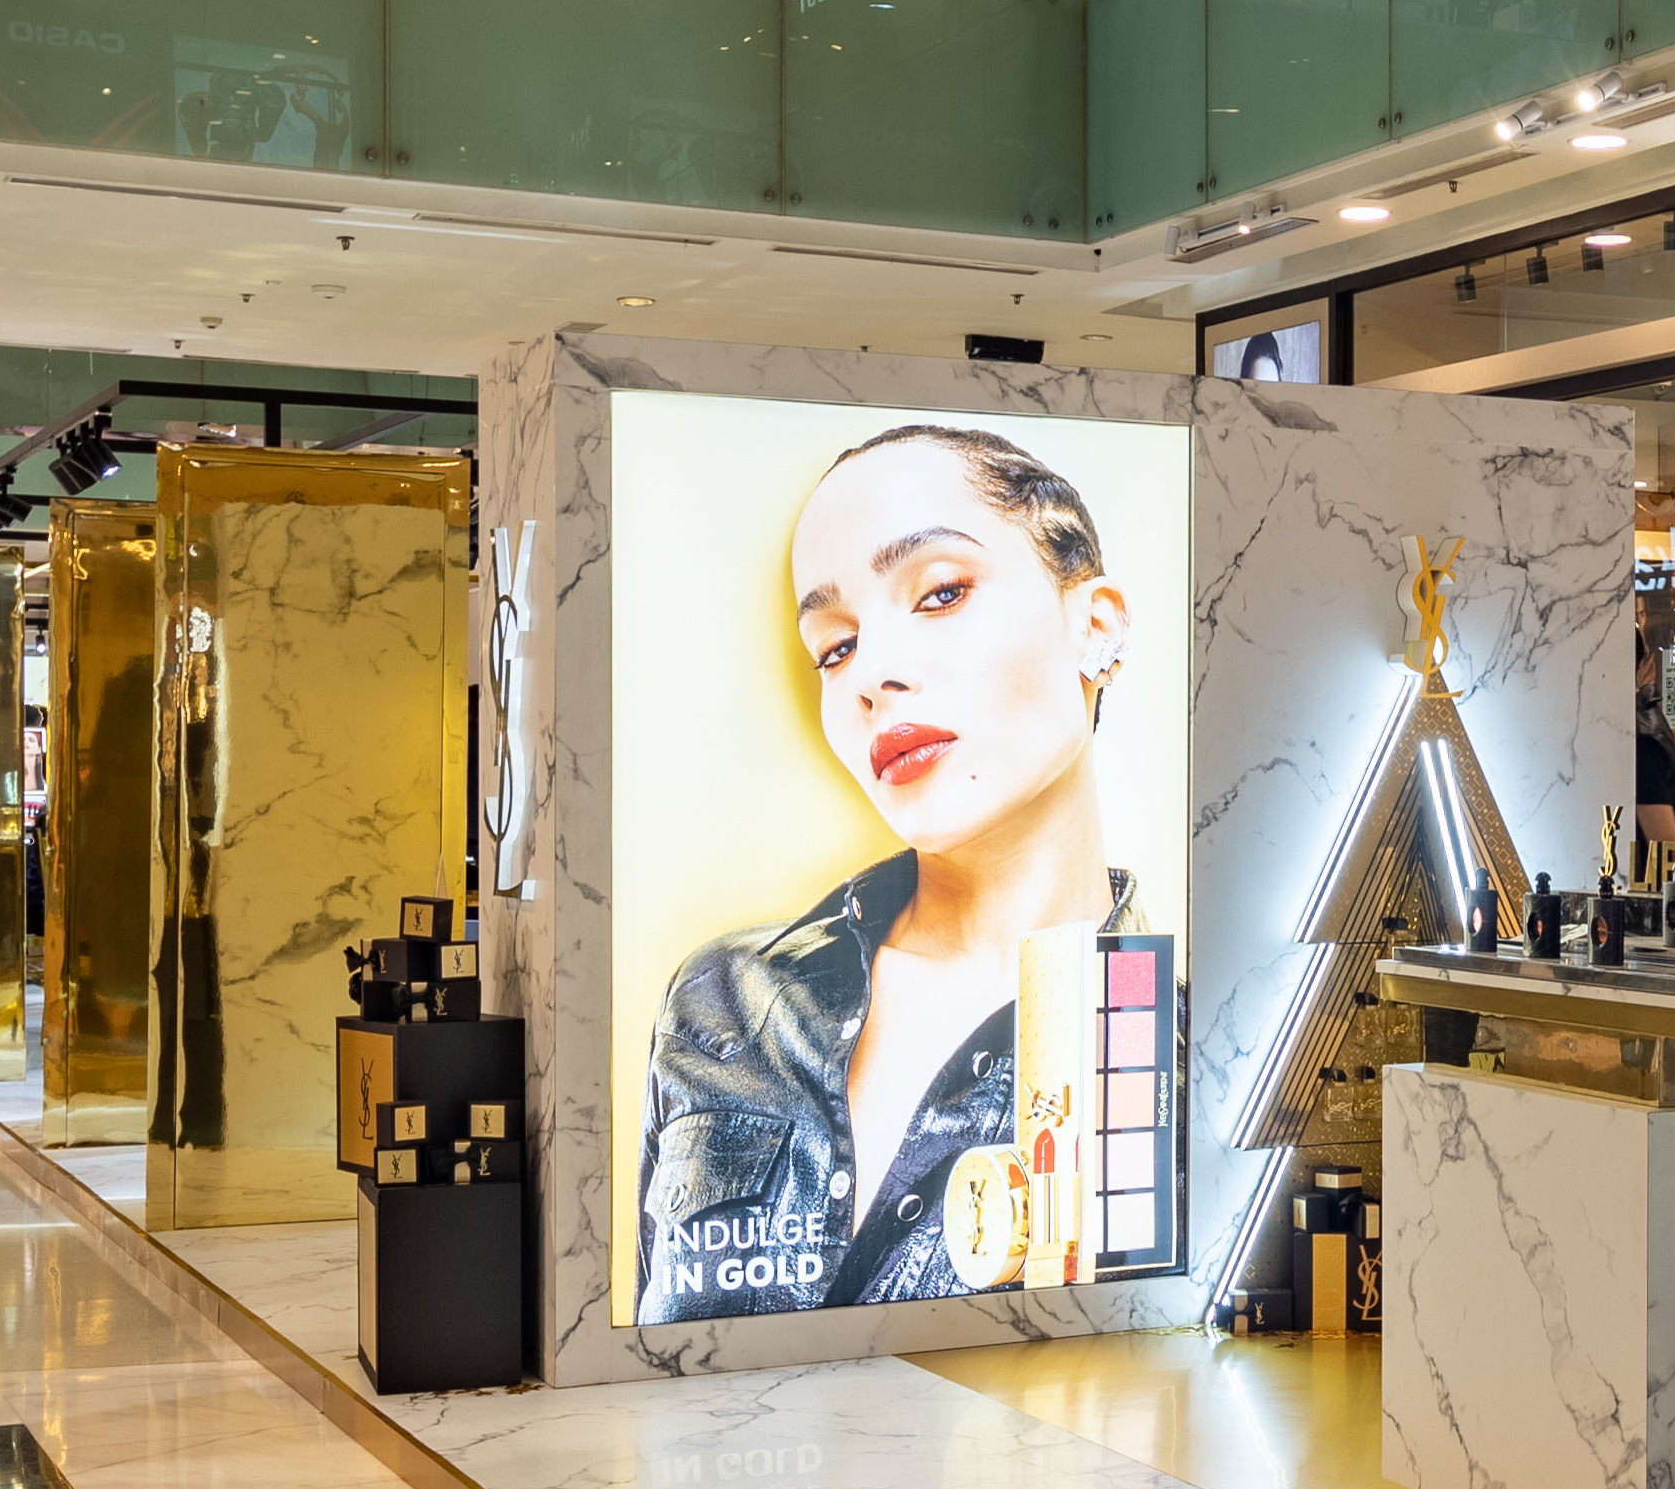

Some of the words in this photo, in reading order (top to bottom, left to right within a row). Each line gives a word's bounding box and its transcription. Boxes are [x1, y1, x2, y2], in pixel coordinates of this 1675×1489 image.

[663, 1213, 823, 1253] INDULGE
[663, 1262, 703, 1295] IN
[716, 1253, 824, 1291] GOLD
